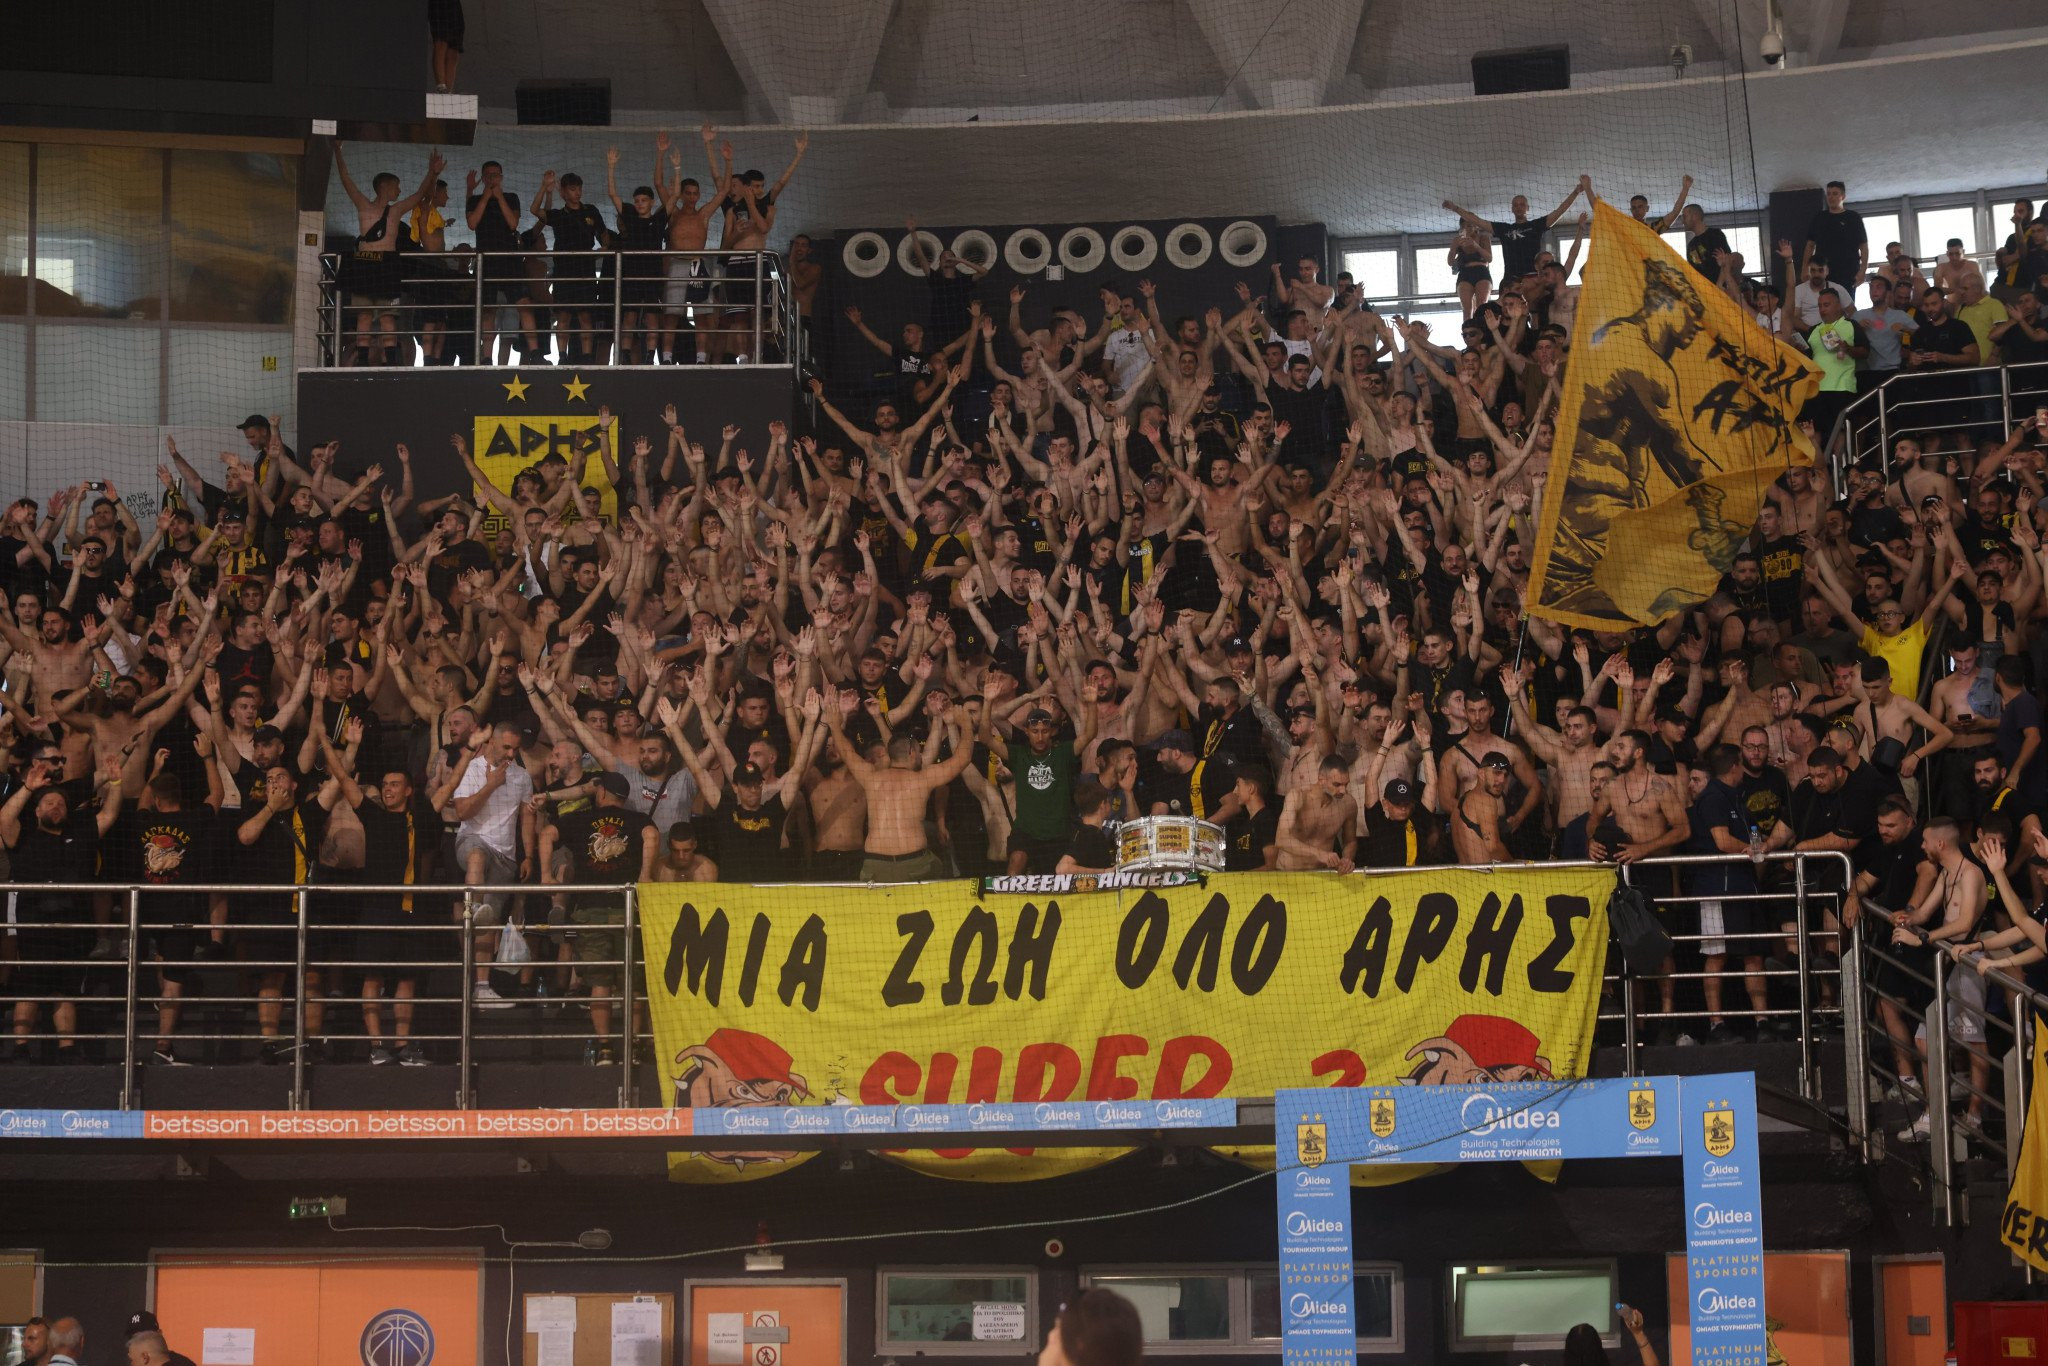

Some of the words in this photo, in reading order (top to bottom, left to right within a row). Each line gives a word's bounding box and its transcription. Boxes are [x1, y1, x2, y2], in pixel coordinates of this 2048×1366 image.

[992, 874, 1072, 892] GREEN
[1097, 871, 1188, 889] ANGELS
[664, 902, 828, 1012] ΜΙΑ
[881, 900, 1062, 1008] ΖΩΗ
[1115, 890, 1287, 996] ΟΛΟ
[1340, 891, 1591, 998] ΑΡΗΣ
[859, 1035, 1233, 1148] SUPER
[0, 1113, 46, 1130] Midea
[63, 1114, 109, 1130] Midea
[724, 1111, 769, 1128] Midea
[785, 1111, 830, 1128] Midea
[846, 1110, 890, 1127] Midea
[904, 1109, 949, 1126] Midea
[969, 1107, 1014, 1124] Midea
[1036, 1106, 1081, 1123] Midea
[1097, 1104, 1141, 1122] Midea
[1157, 1103, 1202, 1121] Midea
[1463, 1098, 1559, 1134] Midea
[151, 1114, 248, 1133] betsson
[261, 1114, 359, 1133] betsson
[368, 1114, 465, 1133] betsson
[477, 1113, 573, 1132] betsson
[583, 1112, 680, 1132] betsson
[1461, 1139, 1498, 1149] Building
[1501, 1138, 1560, 1149] Technologies
[1629, 1134, 1659, 1145] Midea
[1460, 1149, 1496, 1158] ΟΜΙΛΟΣ
[1499, 1148, 1562, 1158] ΤΟΥΡΝΙΚΙΩΤΗ
[1705, 1163, 1739, 1176] Midea
[1298, 1174, 1330, 1187] Midea
[1695, 1207, 1752, 1228] Midea
[1288, 1214, 1342, 1235] Midea
[1735, 1236, 1758, 1244] GROUP
[1692, 1254, 1759, 1266] PLATINUM
[1284, 1263, 1350, 1271] PLATINUM
[1695, 1267, 1758, 1279] SPONSOR
[1287, 1275, 1348, 1284] SPONSOR
[1291, 1297, 1346, 1317] Midea
[1699, 1293, 1756, 1313] Midea
[1287, 1348, 1352, 1357] PLATINUM
[1696, 1344, 1762, 1356] PLATINUM
[1699, 1357, 1760, 1366] SPONSOR
